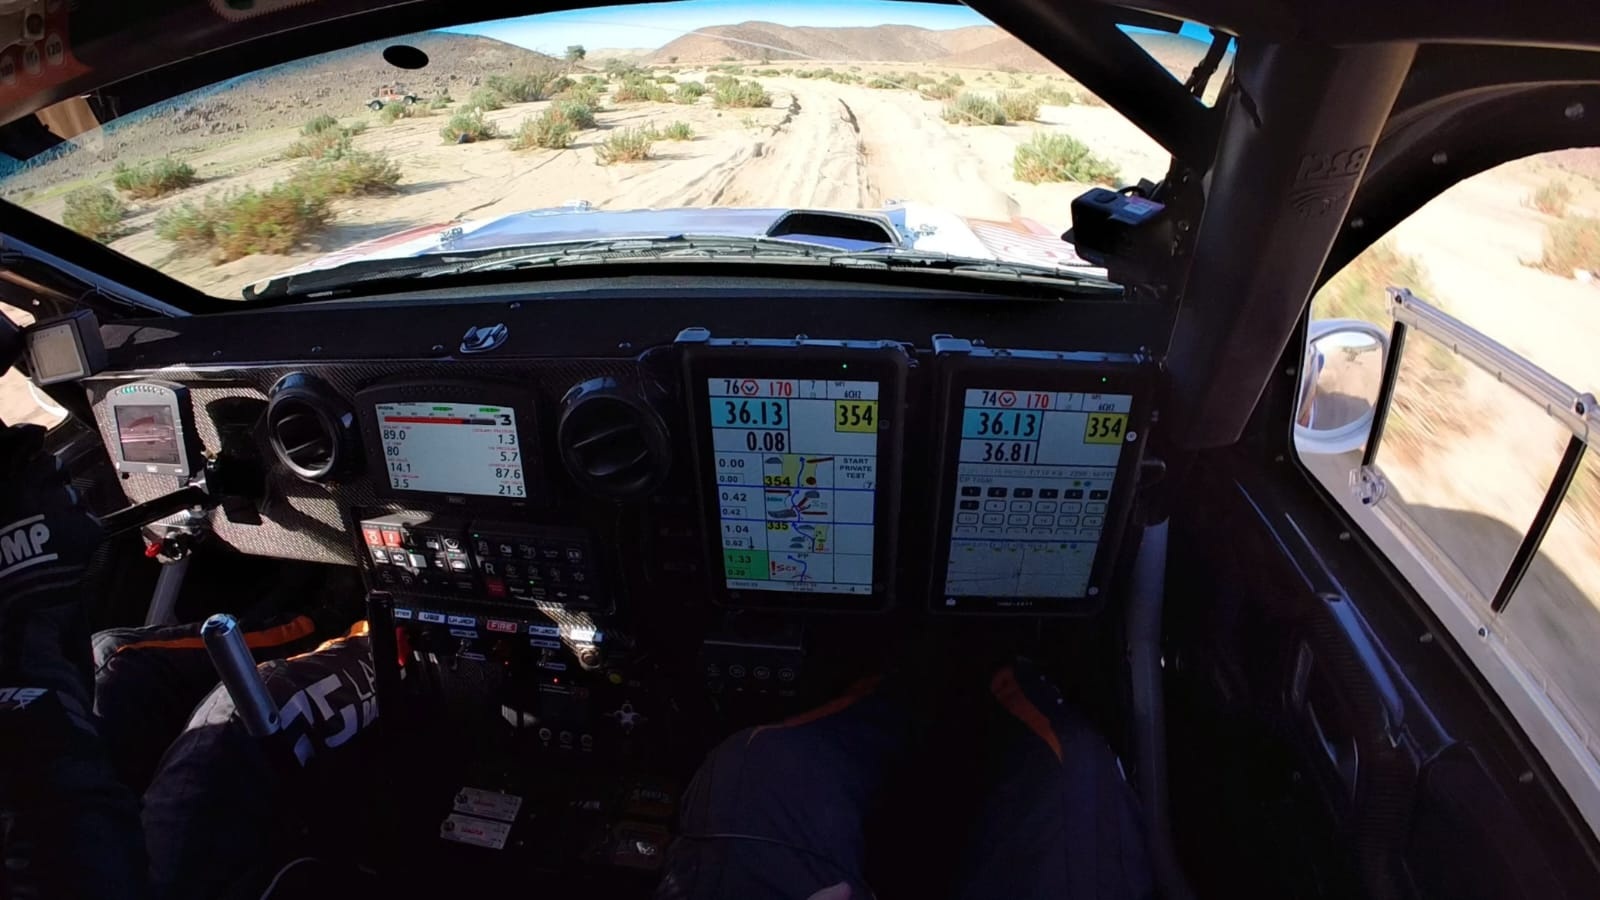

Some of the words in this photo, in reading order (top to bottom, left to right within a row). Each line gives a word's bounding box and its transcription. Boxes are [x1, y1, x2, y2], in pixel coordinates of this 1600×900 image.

[724, 380, 740, 395] 76
[769, 381, 793, 396] 170
[982, 391, 997, 406] 74
[1026, 394, 1049, 408] 170
[725, 401, 783, 425] 36.13
[838, 405, 873, 426] 354
[500, 414, 512, 426] 3
[977, 412, 1036, 436] 36.13
[1088, 417, 1123, 438] 354
[383, 429, 406, 441] 89.0
[498, 434, 515, 445] 1.3
[746, 432, 785, 452] 0.08
[386, 446, 400, 456] 80
[500, 451, 518, 462] 5.7
[982, 443, 1031, 462] 36.81
[390, 463, 411, 473] 14.1
[719, 458, 745, 468] 0.00
[495, 468, 521, 479] 87.6
[719, 475, 738, 483] 0.00
[393, 478, 409, 488] 3.5
[765, 475, 791, 487] 354
[498, 485, 524, 496] 21.5
[722, 492, 747, 502] 0.42
[725, 524, 749, 533] 1.04
[767, 521, 789, 530] 335
[0, 523, 51, 566] MP
[728, 555, 751, 564] 1.33
[490, 622, 514, 631] FIRE
